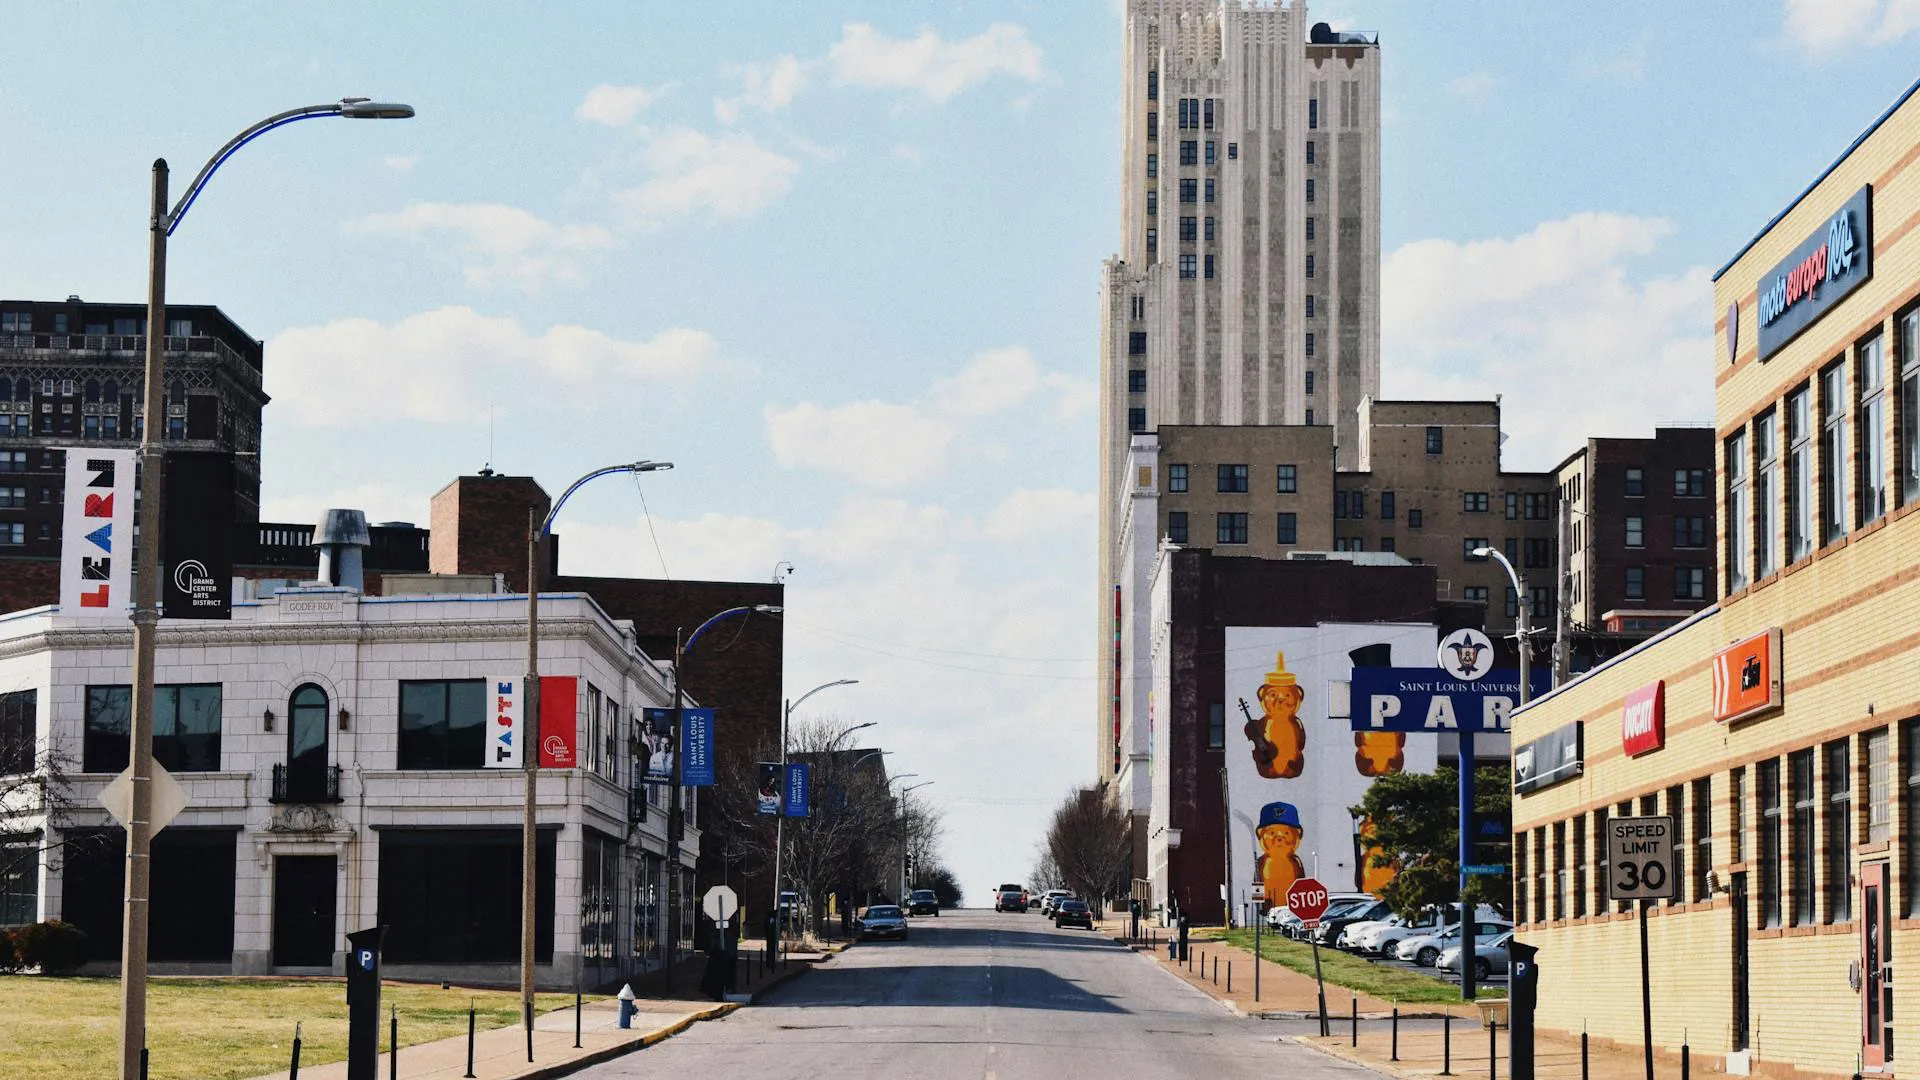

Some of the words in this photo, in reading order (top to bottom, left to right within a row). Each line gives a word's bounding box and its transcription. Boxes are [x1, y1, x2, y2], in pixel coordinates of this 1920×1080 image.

[80, 459, 115, 608] LEARN
[496, 682, 513, 762] TASTE
[690, 715, 698, 740] LOUIS
[1624, 698, 1653, 740] DUCATI
[690, 742, 698, 766] SAINT
[1615, 824, 1666, 838] SPEED
[1622, 840, 1660, 854] LIMIT
[1616, 860, 1666, 891] 30
[1290, 890, 1326, 909] STOP
[361, 950, 372, 967] P
[1516, 961, 1526, 976] P
